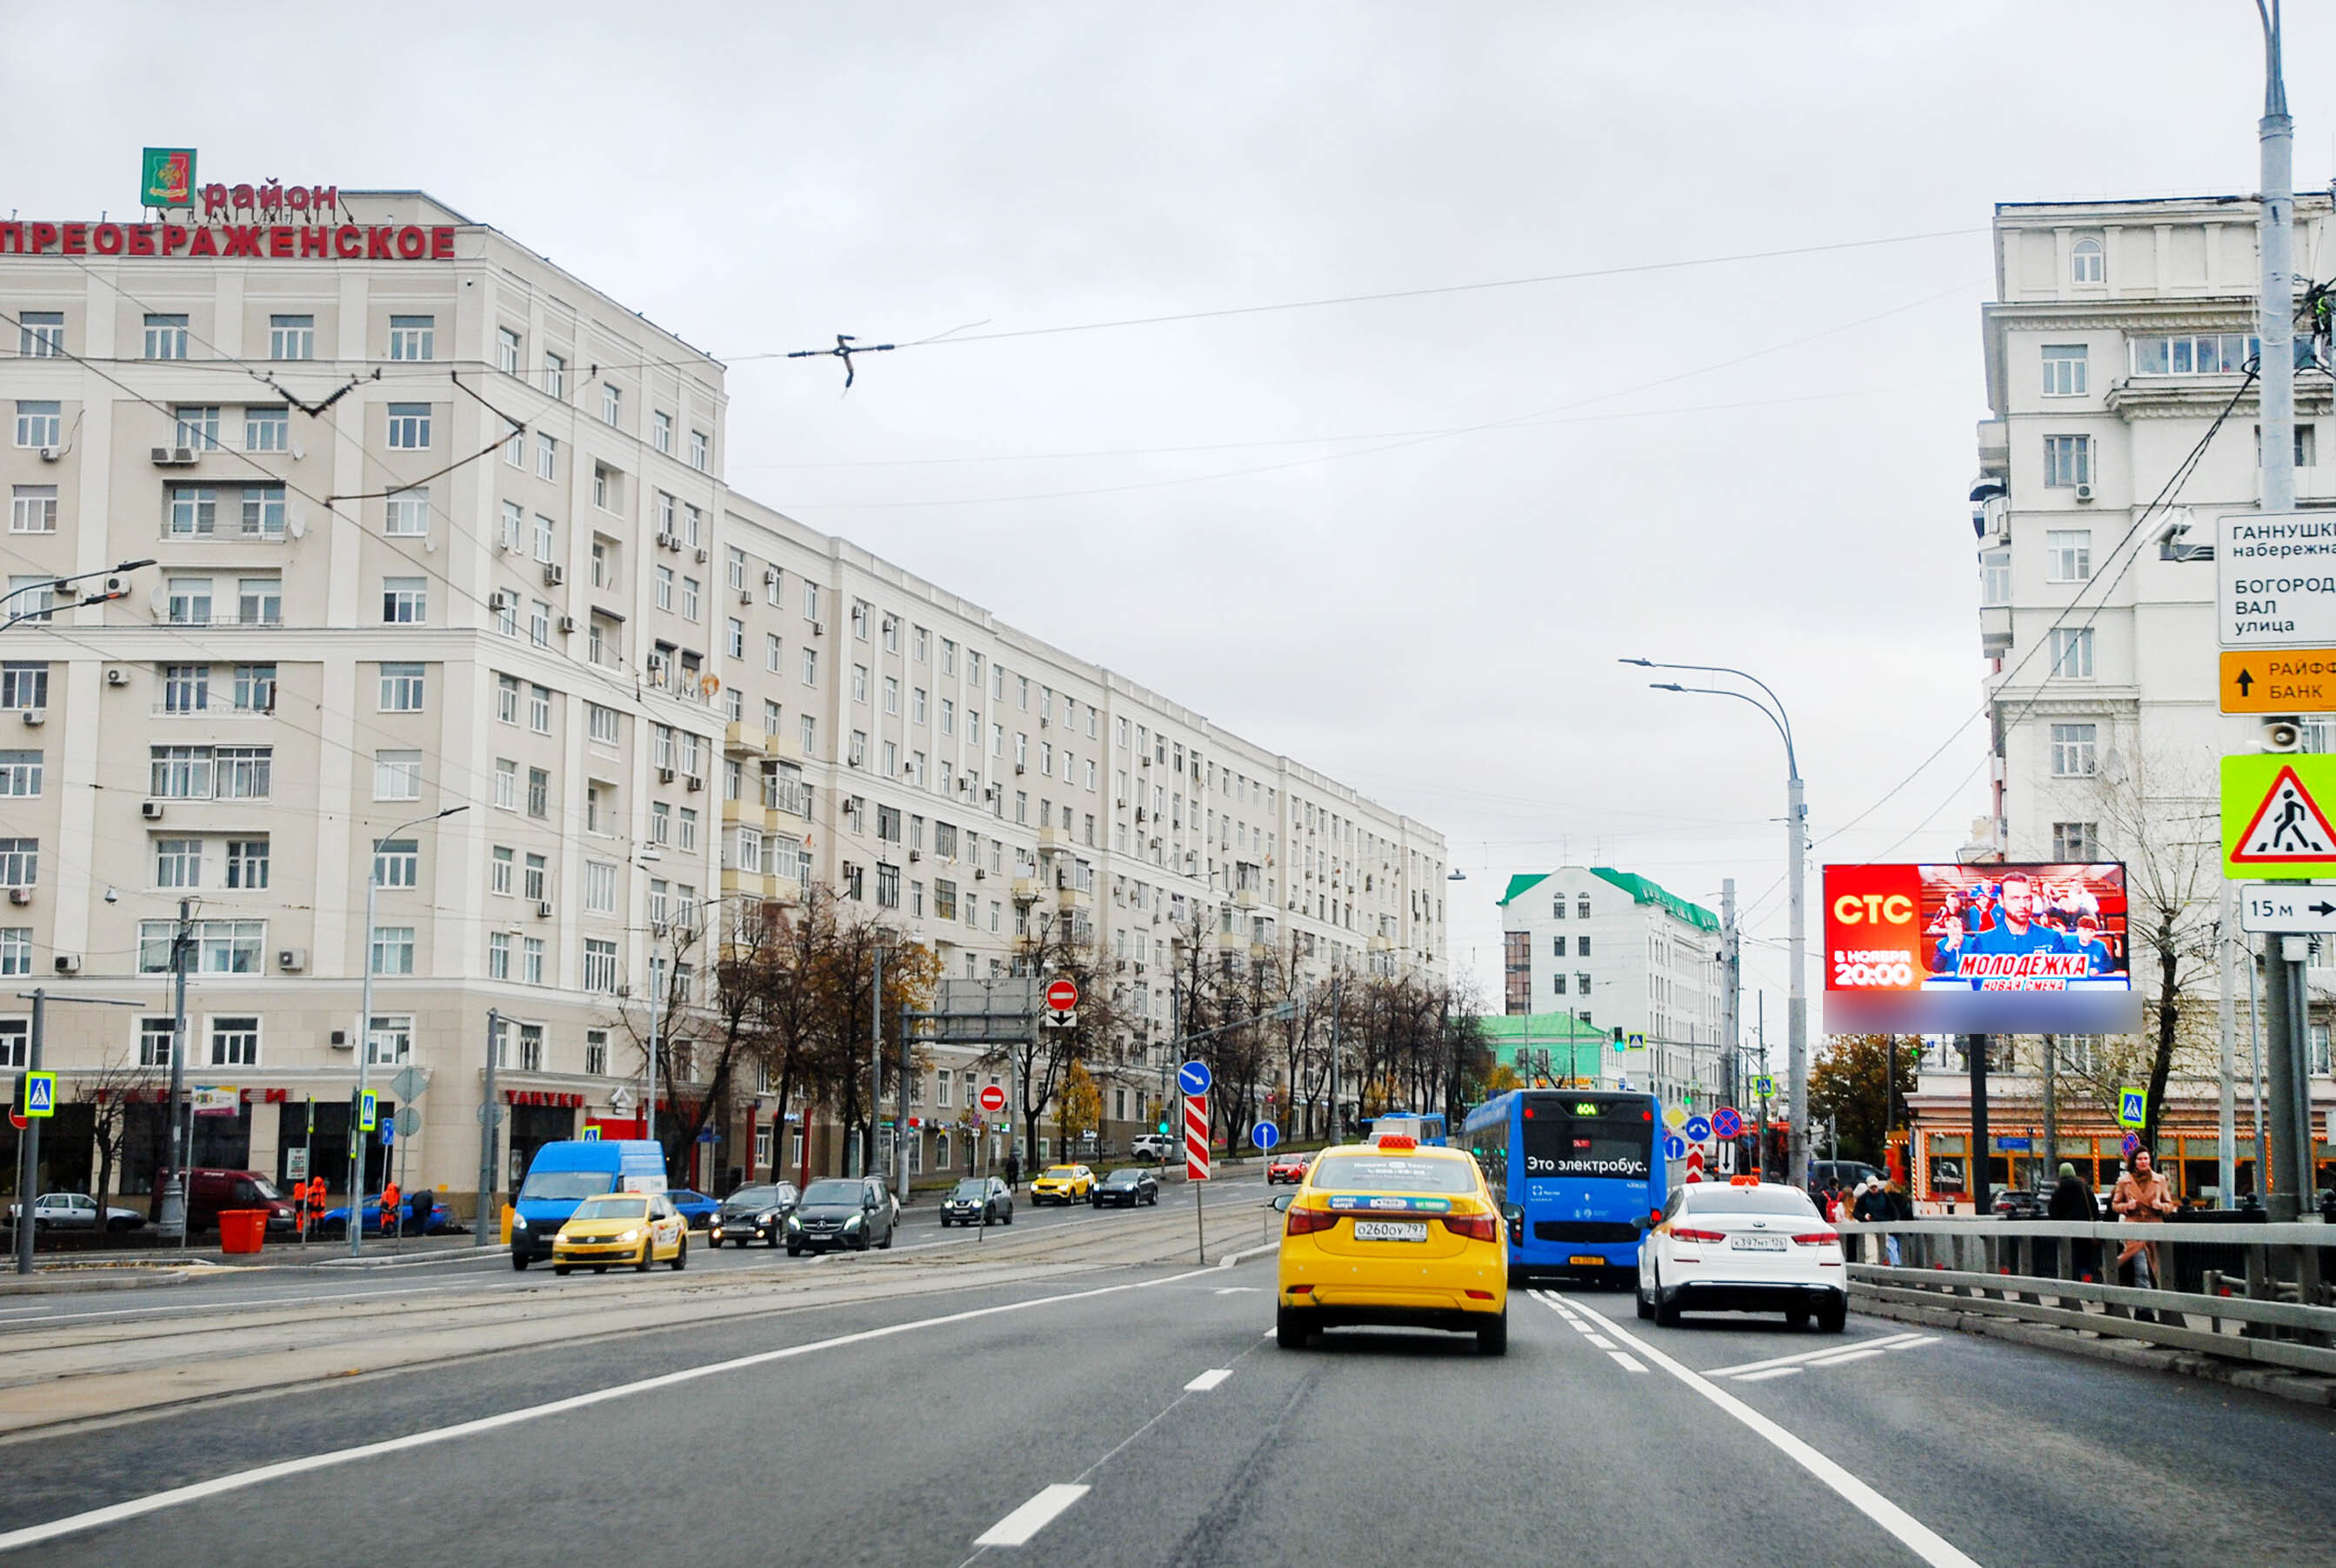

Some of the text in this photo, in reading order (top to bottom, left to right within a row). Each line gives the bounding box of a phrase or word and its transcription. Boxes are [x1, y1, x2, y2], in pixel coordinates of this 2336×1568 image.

[204, 177, 337, 216] район
[0, 223, 455, 258] ПРЕОБРАЖЕНСКОЕ
[2233, 523, 2336, 539] ГАННУШК
[2235, 577, 2336, 594] БОГОРОД
[2235, 600, 2276, 614] ВАЛ
[2235, 620, 2295, 636] улица
[2269, 684, 2323, 698] БАНК
[1833, 894, 1912, 924] СТС
[2252, 900, 2273, 917] 15
[1847, 950, 1911, 963] НОЯБРЯ
[1959, 951, 2086, 977] МОЛОДЁЖКА
[1834, 963, 1912, 985] 20:00
[1982, 980, 2064, 991] НОВАЯ СМЕНА
[506, 1090, 585, 1108] ТАНУКИ
[1576, 1103, 1597, 1116] 604
[1527, 1156, 1647, 1174] Это электробус.
